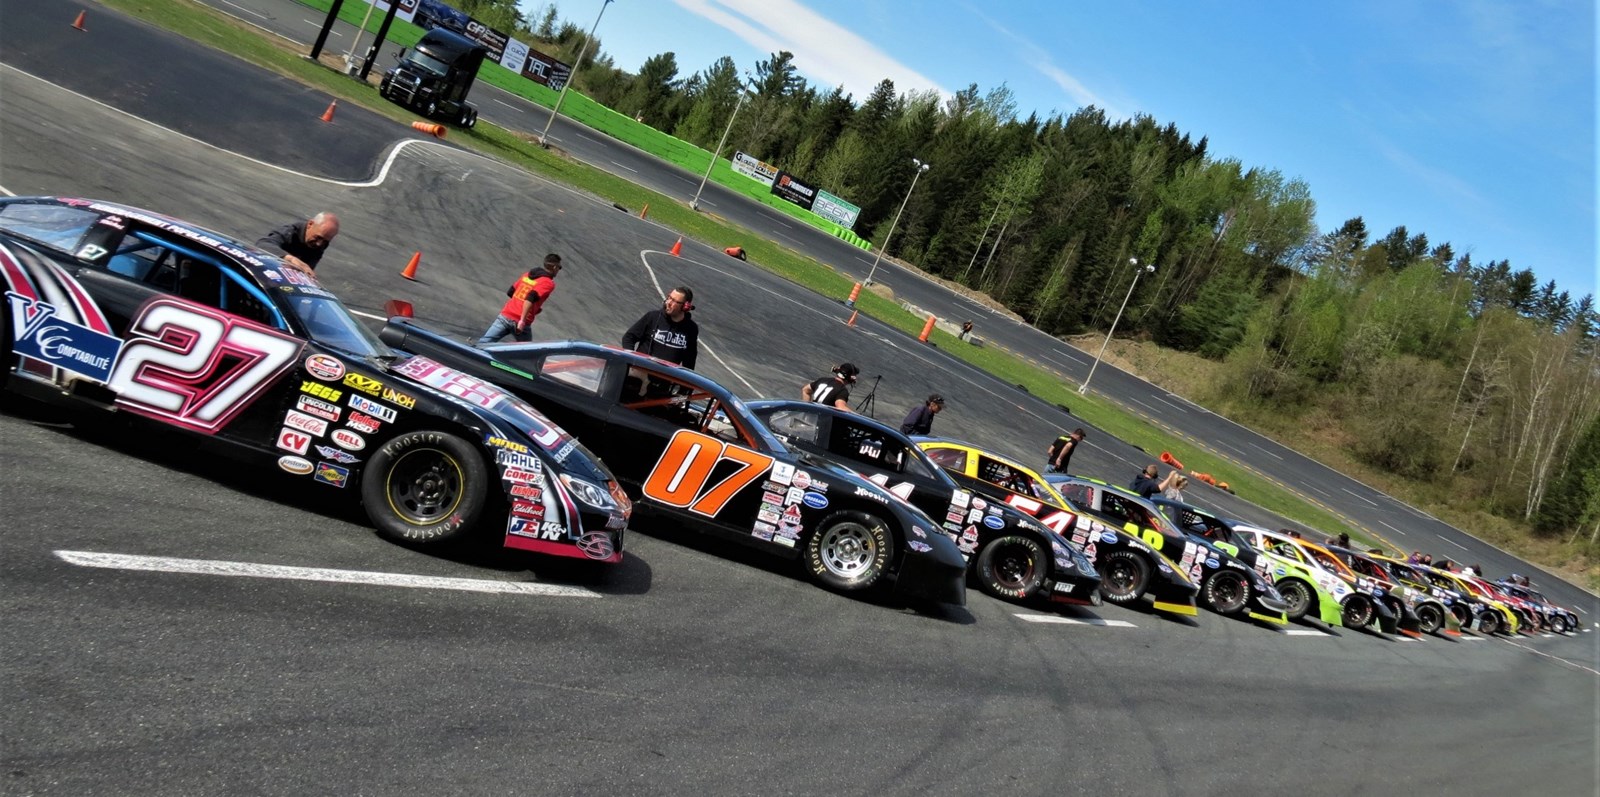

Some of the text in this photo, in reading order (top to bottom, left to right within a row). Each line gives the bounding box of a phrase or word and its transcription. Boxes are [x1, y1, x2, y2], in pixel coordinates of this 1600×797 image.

[75, 244, 109, 261] 27
[110, 295, 305, 435] 27
[300, 381, 343, 402] JEGS
[382, 387, 416, 408] UNOH
[301, 396, 335, 412] LINCOLN
[352, 397, 381, 415] Mobil
[345, 420, 374, 434] MSD
[348, 411, 381, 429] Holley
[282, 433, 307, 450] CV
[336, 432, 360, 447] BELL
[499, 450, 541, 470] MAHLE
[505, 469, 535, 482] COMP
[642, 428, 776, 519] 07
[854, 486, 889, 505] Hoosier
[513, 503, 544, 517] Edelbrock
[510, 519, 537, 534] JE
[811, 531, 827, 575] Hoosier
[871, 525, 886, 569] Hoosier
